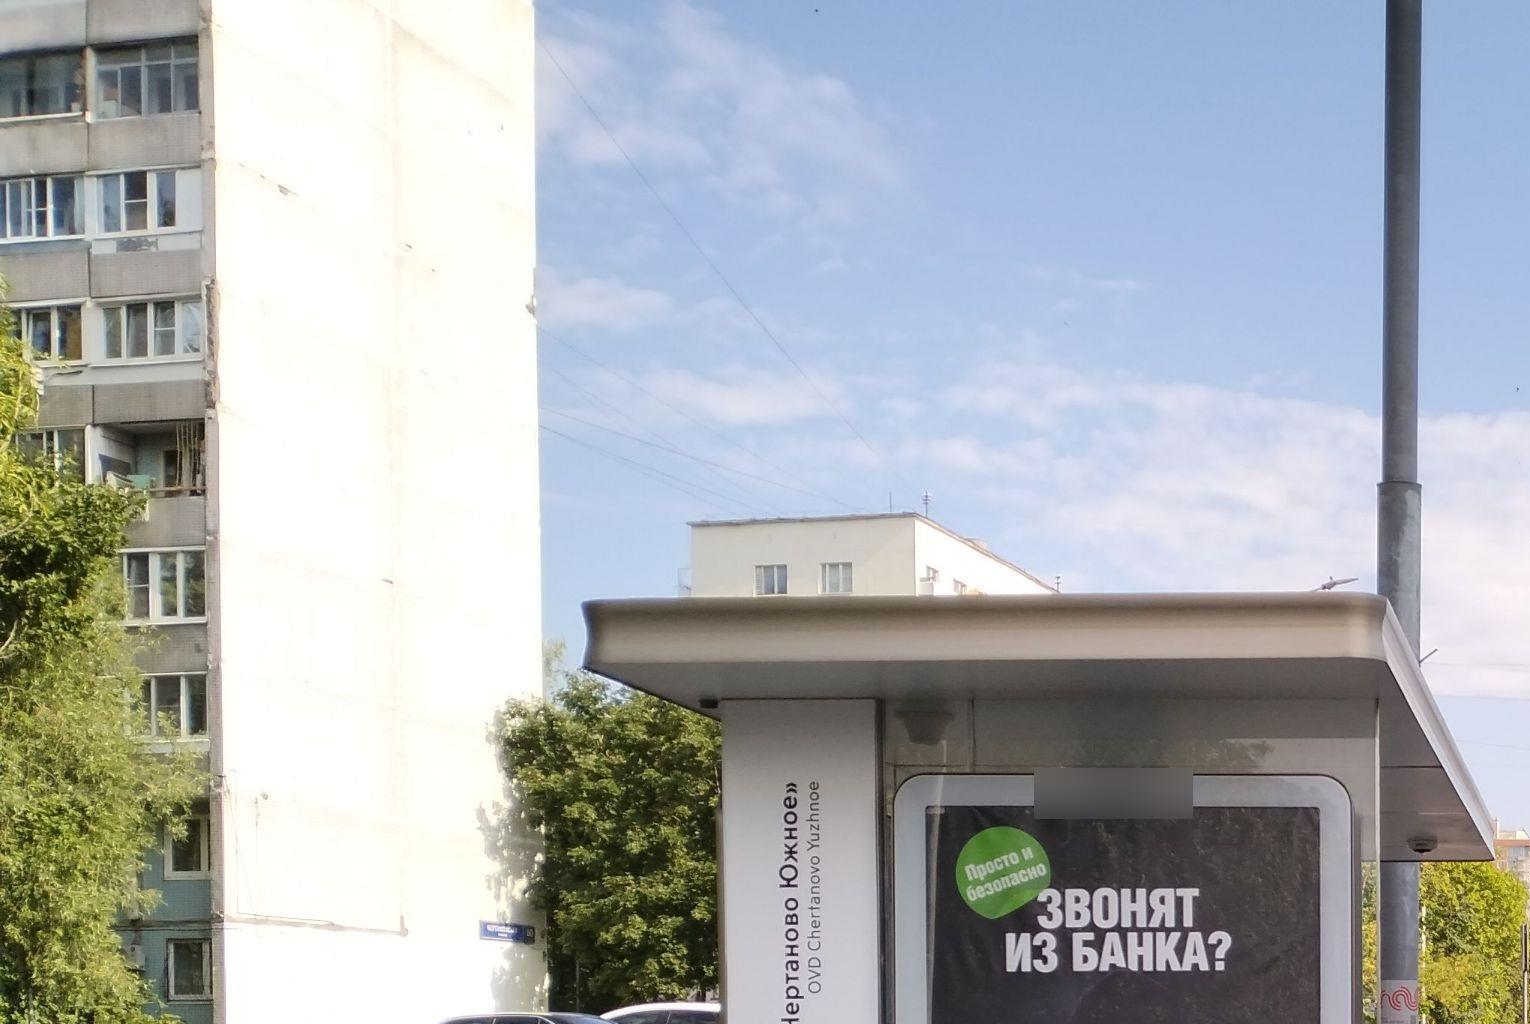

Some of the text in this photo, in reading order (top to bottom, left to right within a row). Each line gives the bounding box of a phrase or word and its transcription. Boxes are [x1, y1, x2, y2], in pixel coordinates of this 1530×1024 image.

[779, 782, 799, 888] Южное»
[964, 846, 1034, 881] Просто и
[965, 863, 1047, 902] безопасно
[805, 781, 821, 994] OVD Chertanovo Yuzhnoe
[1036, 887, 1200, 930] ЗВОНЯТ
[1005, 930, 1233, 973] ИЗ БАНКА?
